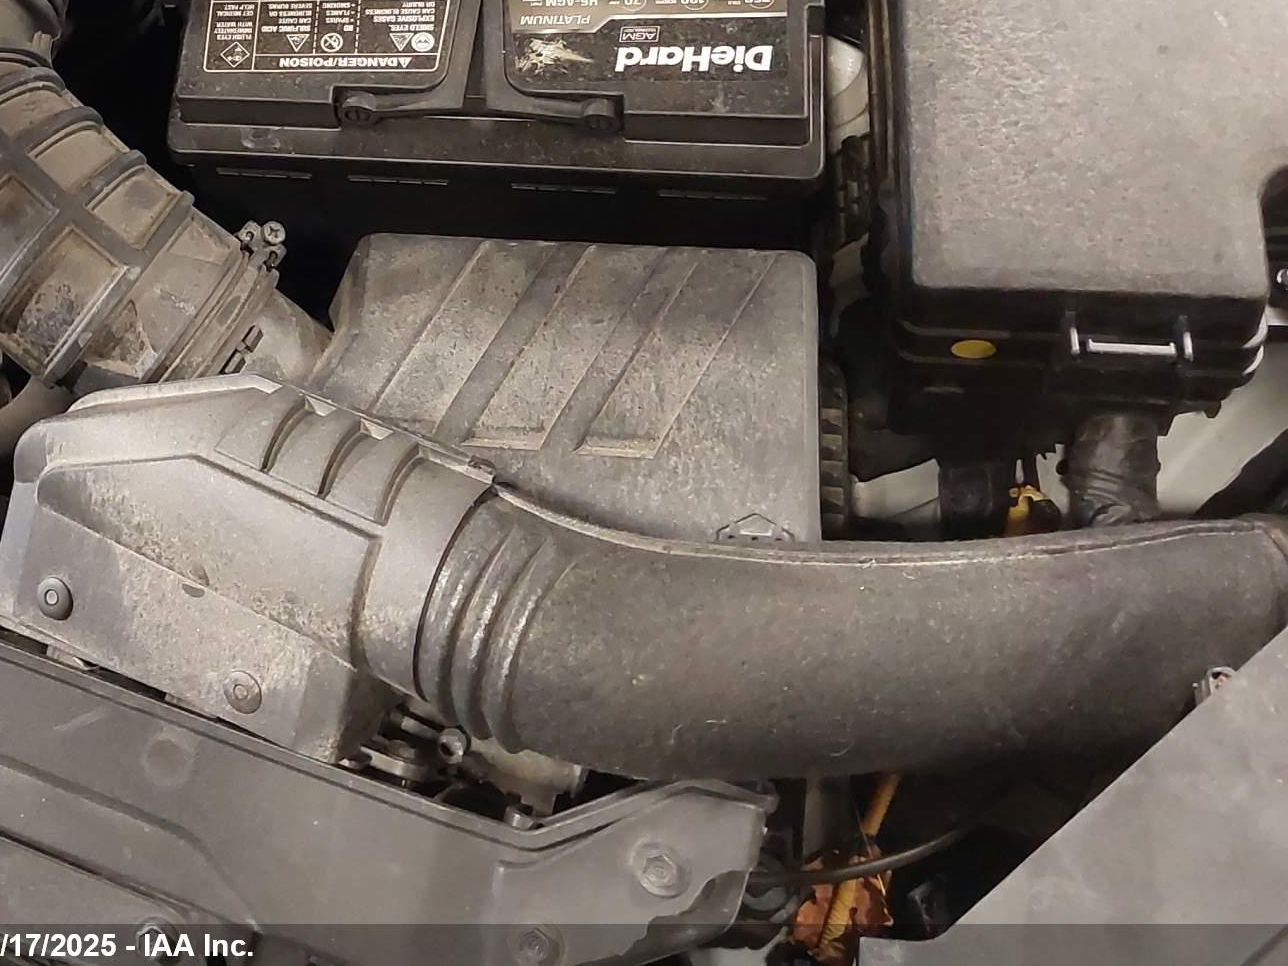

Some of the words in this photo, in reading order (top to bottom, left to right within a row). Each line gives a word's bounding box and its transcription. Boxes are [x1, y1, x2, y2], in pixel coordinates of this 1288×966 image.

[520, 15, 590, 24] PLATINUM
[279, 57, 398, 67] DANGER/POISON
[614, 45, 774, 73] DieHard
